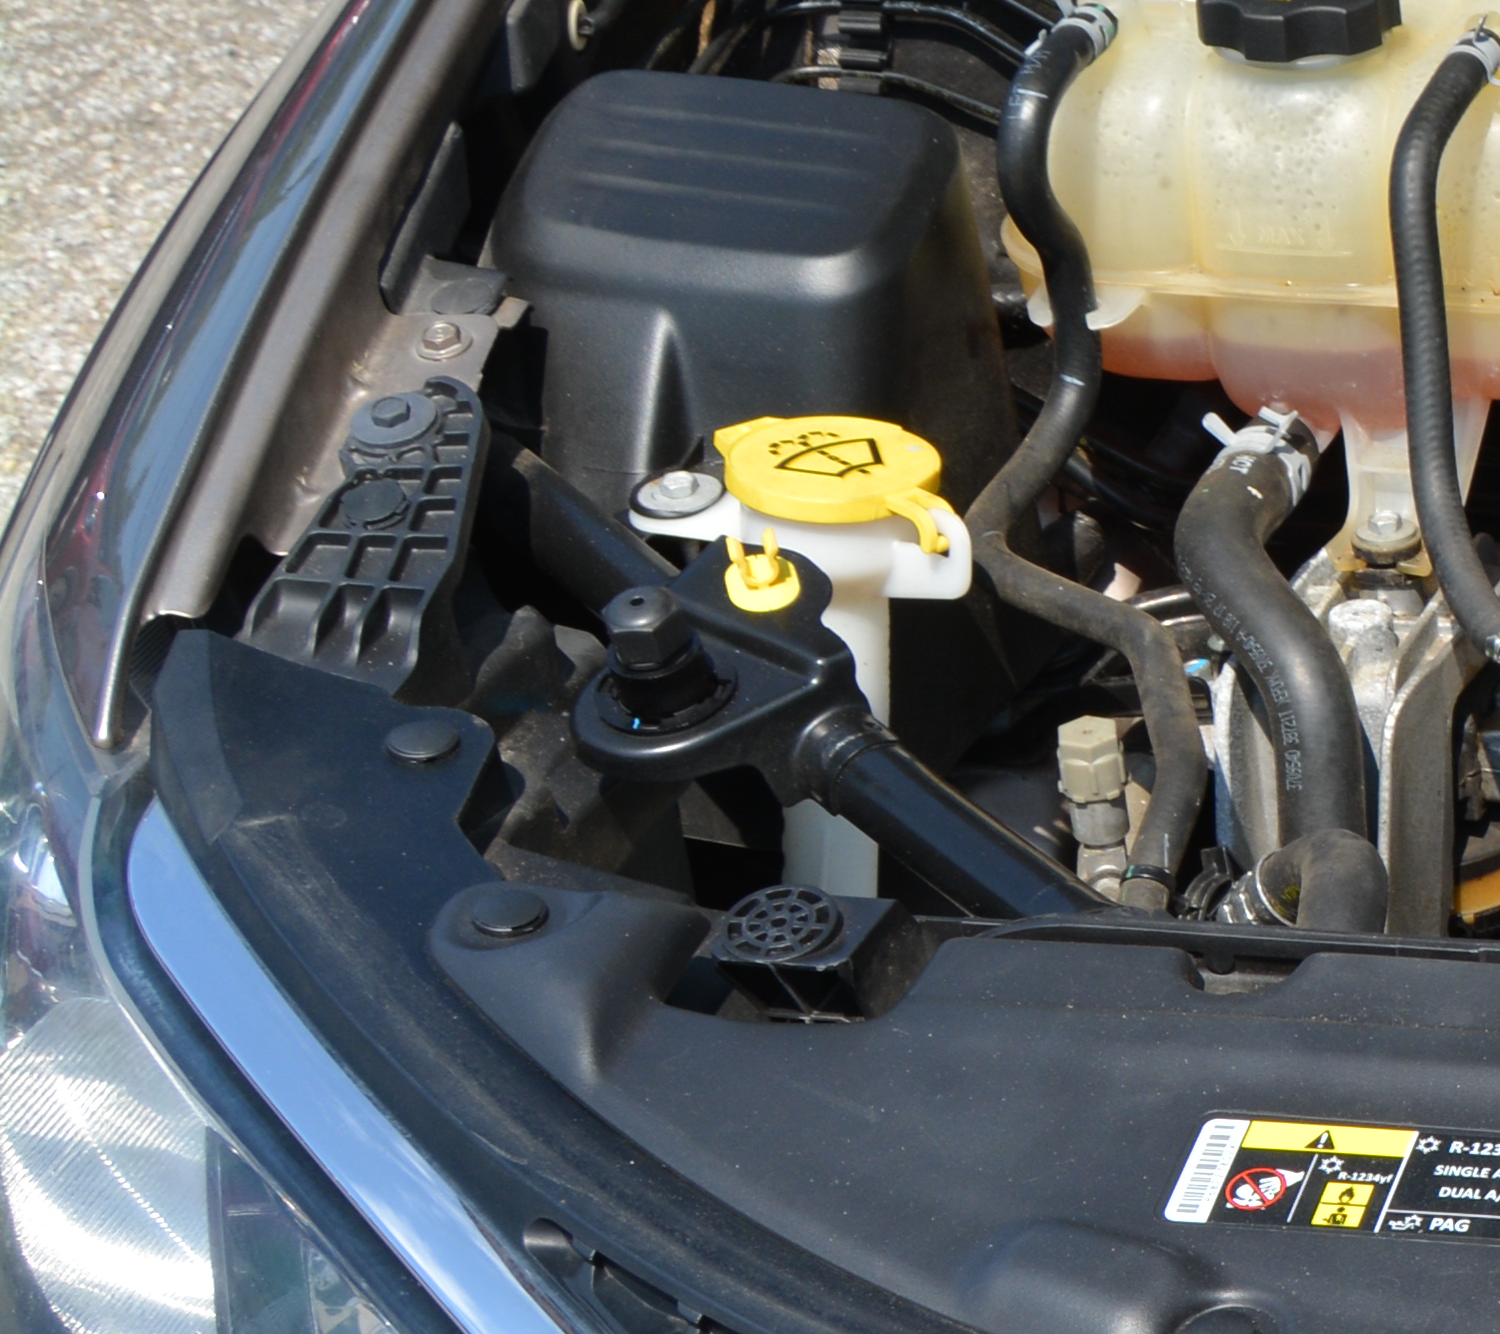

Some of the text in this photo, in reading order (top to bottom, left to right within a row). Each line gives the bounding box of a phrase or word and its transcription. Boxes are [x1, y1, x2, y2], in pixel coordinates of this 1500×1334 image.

[1337, 1171, 1394, 1184] R-1234yf
[1433, 1164, 1491, 1179] SINGLE
[1438, 1186, 1482, 1200] DUAL
[1428, 1217, 1471, 1233] PAG
